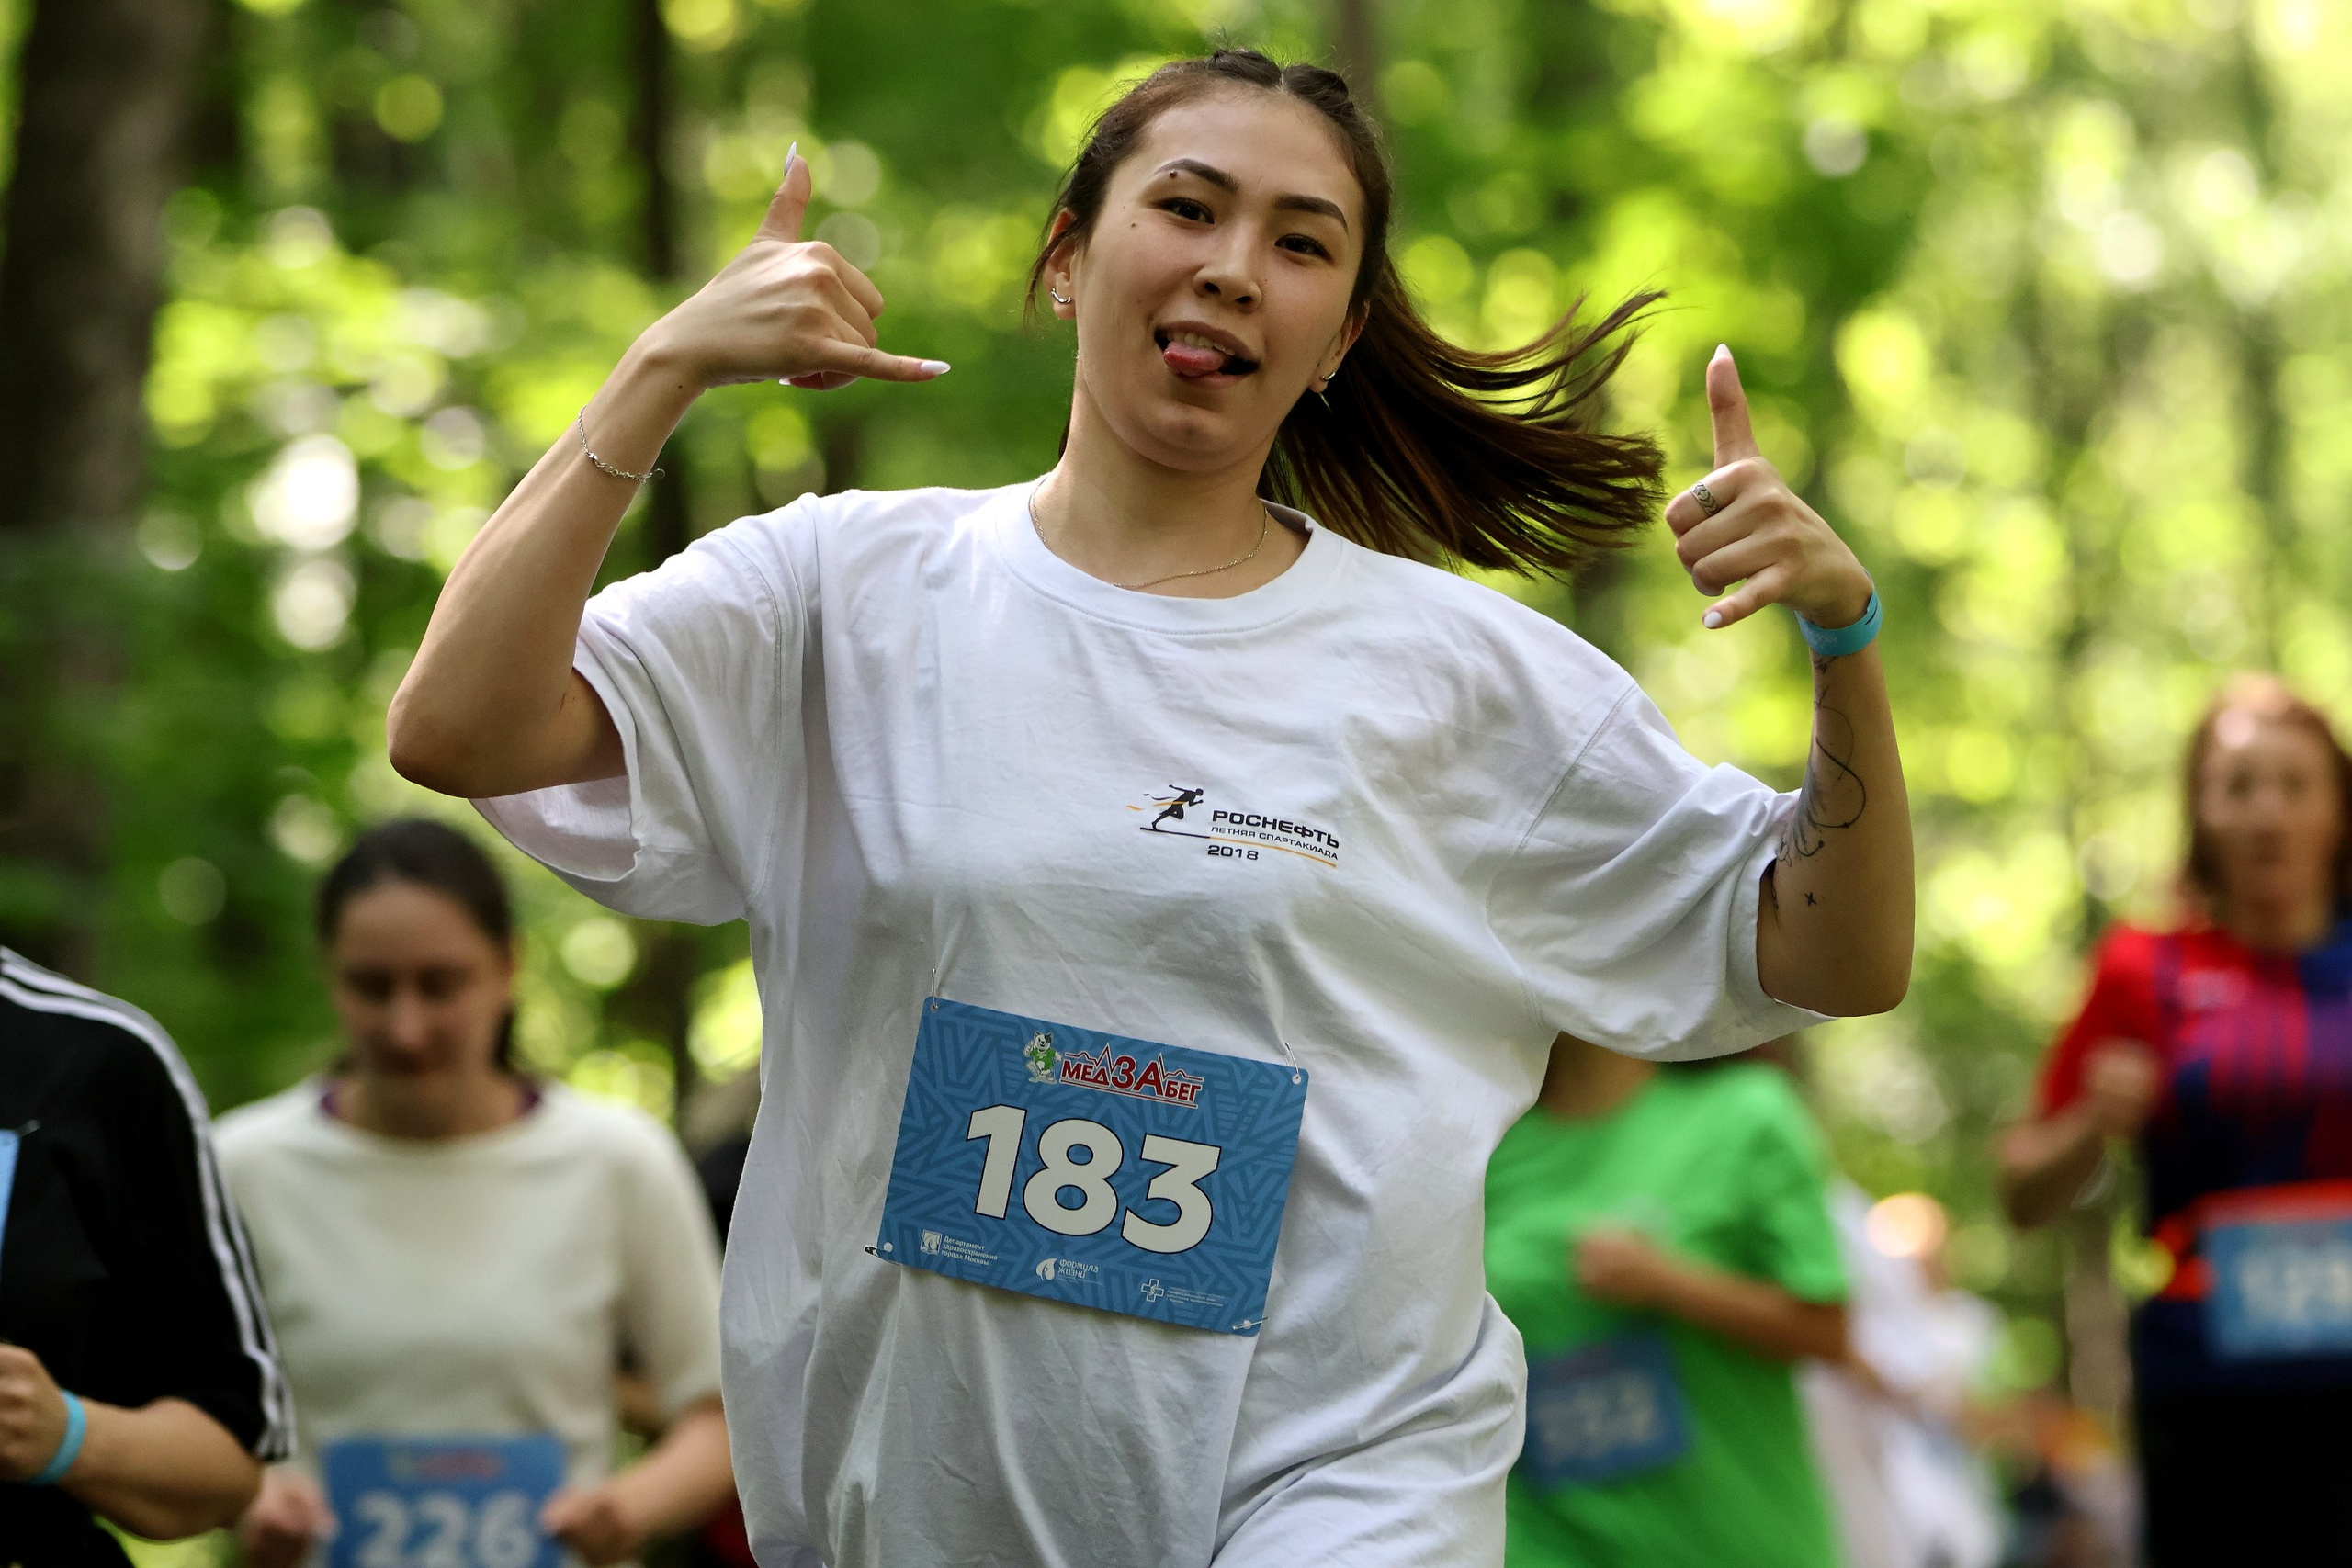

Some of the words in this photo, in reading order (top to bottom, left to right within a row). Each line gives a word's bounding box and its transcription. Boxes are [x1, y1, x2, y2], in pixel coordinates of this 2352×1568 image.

[1212, 809, 1340, 849] РОСНЕФТЬ
[1207, 844, 1259, 861] 2018
[1211, 826, 1256, 838] ЛЕТНЯЯ
[1259, 832, 1339, 861] СПАРТАКИАДА
[966, 1103, 1222, 1254] 183
[942, 1243, 998, 1261] здравоохранения
[944, 1235, 985, 1250] Департамент
[941, 1250, 964, 1260] города
[964, 1255, 989, 1266] Москвы
[354, 1489, 538, 1568] 226
